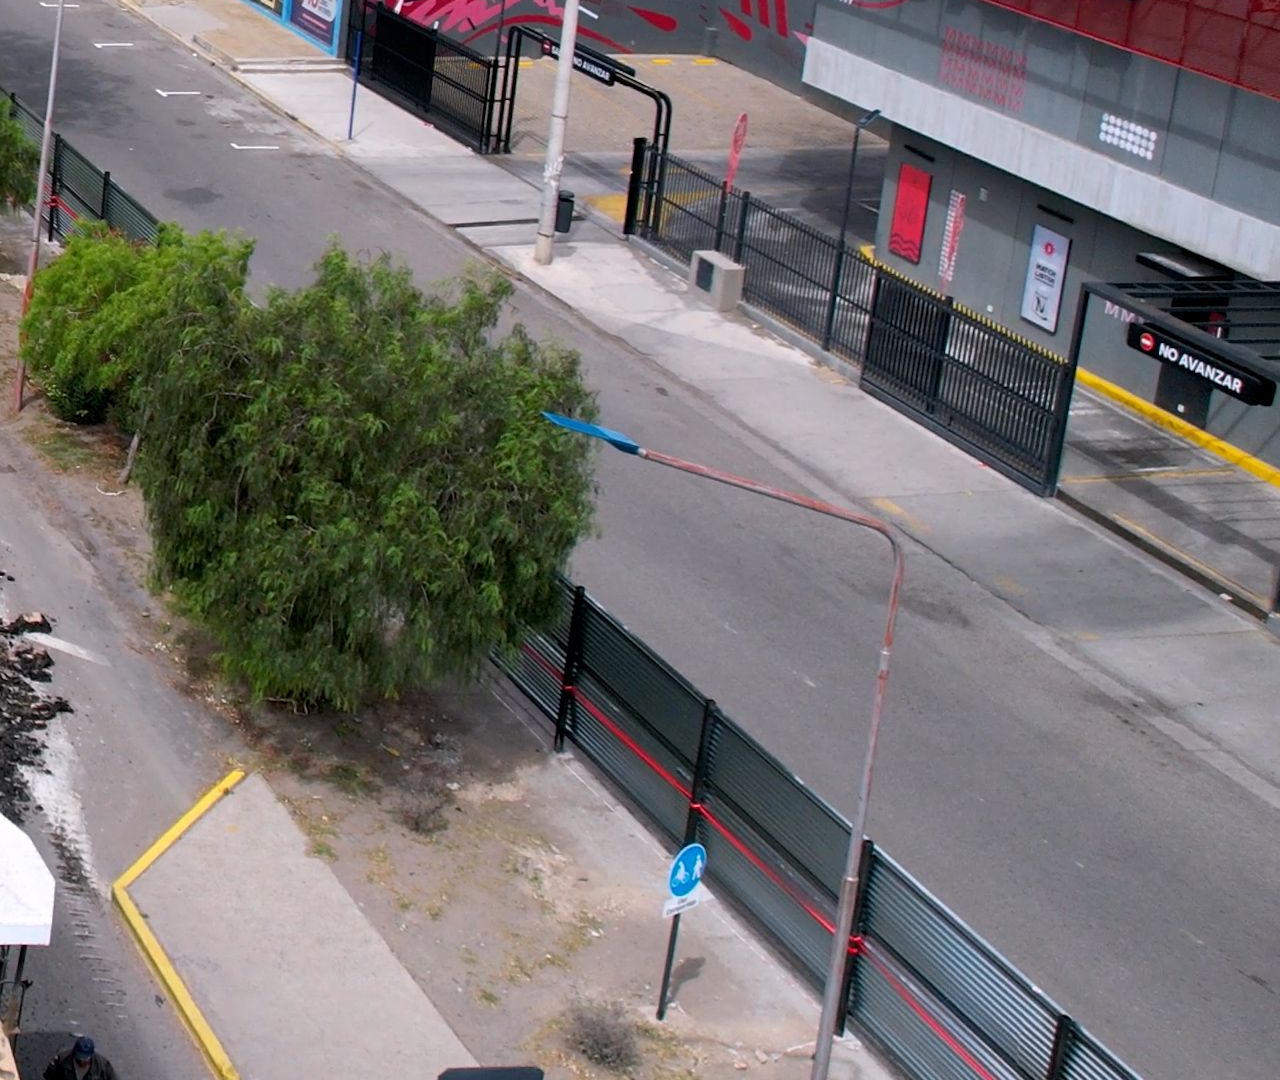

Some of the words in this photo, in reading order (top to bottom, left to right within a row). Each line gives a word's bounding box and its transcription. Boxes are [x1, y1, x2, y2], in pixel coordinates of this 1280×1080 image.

[582, 61, 611, 81] AVANZAR
[1158, 342, 1179, 362] NO
[1179, 354, 1244, 394] AVANZAR
